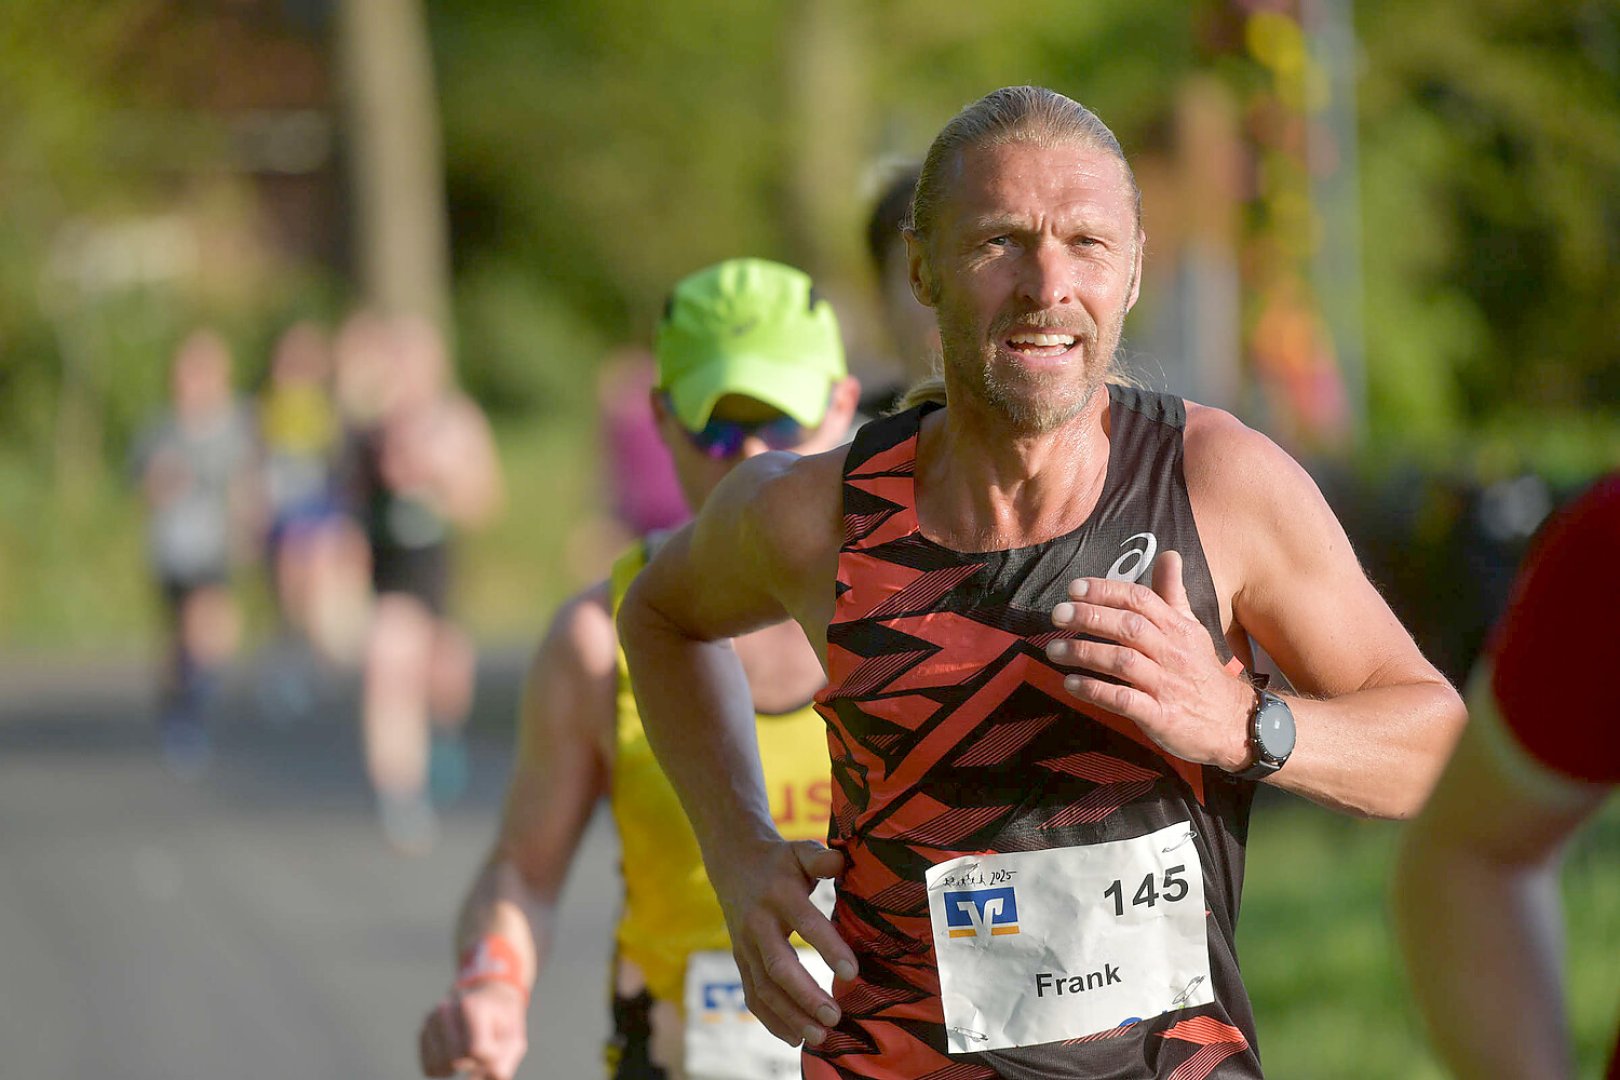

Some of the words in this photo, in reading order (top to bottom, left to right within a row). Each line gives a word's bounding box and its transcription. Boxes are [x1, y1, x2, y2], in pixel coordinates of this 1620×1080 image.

[990, 869, 1017, 886] 2025
[1104, 864, 1189, 916] 145
[1036, 963, 1121, 997] Frank
